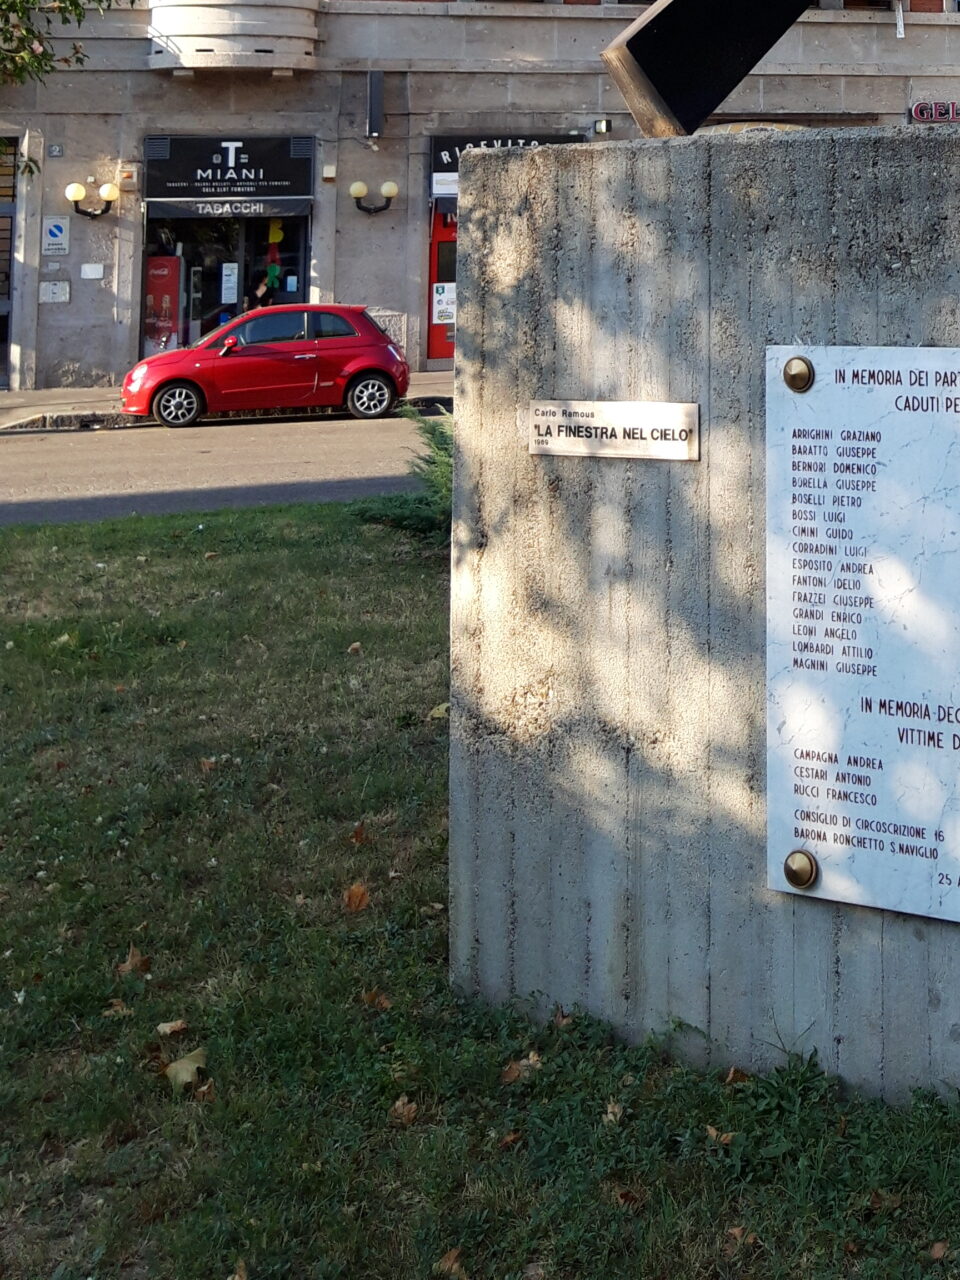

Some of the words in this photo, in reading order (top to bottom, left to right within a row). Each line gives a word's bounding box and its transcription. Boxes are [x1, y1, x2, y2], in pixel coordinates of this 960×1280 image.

[197, 169, 264, 180] MIANI
[196, 203, 264, 214] TABACCHI
[835, 369, 845, 384] IN
[852, 369, 902, 386] MEMORIA
[909, 371, 928, 387] DEI
[895, 396, 939, 412] CADUTI
[535, 409, 556, 417] Carlo
[562, 410, 595, 419] Ramous
[558, 425, 618, 439] FINESTRA
[623, 428, 647, 440] NEL
[792, 429, 833, 440] ARRIGHINI
[841, 430, 881, 443] GRAZIANO
[792, 445, 828, 457] BARATTO
[837, 446, 877, 459] GIUSEPPE
[792, 461, 826, 473] BERNORI
[834, 462, 877, 475] DOMENICO
[792, 477, 828, 489] BORELLA
[836, 479, 877, 492] GIUSEPPE
[792, 493, 825, 506] BOSELLI
[833, 496, 862, 507] PIETRO
[792, 510, 816, 521] BOSSI
[824, 511, 846, 523] LUIGI
[793, 526, 818, 538] CIMINI
[826, 528, 853, 540] GUIDO
[793, 542, 837, 555] CORRADINI
[845, 546, 867, 558] LUIGI
[792, 558, 832, 572] ESPOSITO
[840, 563, 874, 575] ANDREA
[792, 575, 827, 588] FANTONI
[834, 579, 861, 590] IDELIO
[833, 595, 874, 608] GIUSEPPE
[793, 608, 824, 620] GRANDI
[832, 611, 862, 624] ENRICO
[793, 624, 816, 636] LEONI
[824, 627, 857, 641] ANGELO
[793, 641, 834, 655] LOMBARDI
[842, 646, 873, 659] ATTILIO
[793, 658, 828, 672] MAGNINI
[836, 662, 877, 677] GIUSEPPE
[861, 697, 872, 713] IN
[879, 699, 931, 720] MEMORIA
[898, 727, 944, 749] VITTIME
[794, 748, 839, 765] CAMPAGNA
[847, 755, 884, 771] ANDREA
[794, 766, 827, 781] CESTARI
[835, 772, 871, 787] ANTONIO
[794, 784, 819, 798] RUCCI
[827, 788, 877, 806] FRANCESCO
[795, 809, 837, 826] CONSIGLIO
[843, 816, 851, 828] DI
[856, 818, 926, 840] CIRCOSCRIZIONE
[934, 830, 945, 843] 16
[794, 827, 827, 843] BARONA
[833, 833, 885, 852] RONCHETTO
[938, 872, 952, 886] 25
